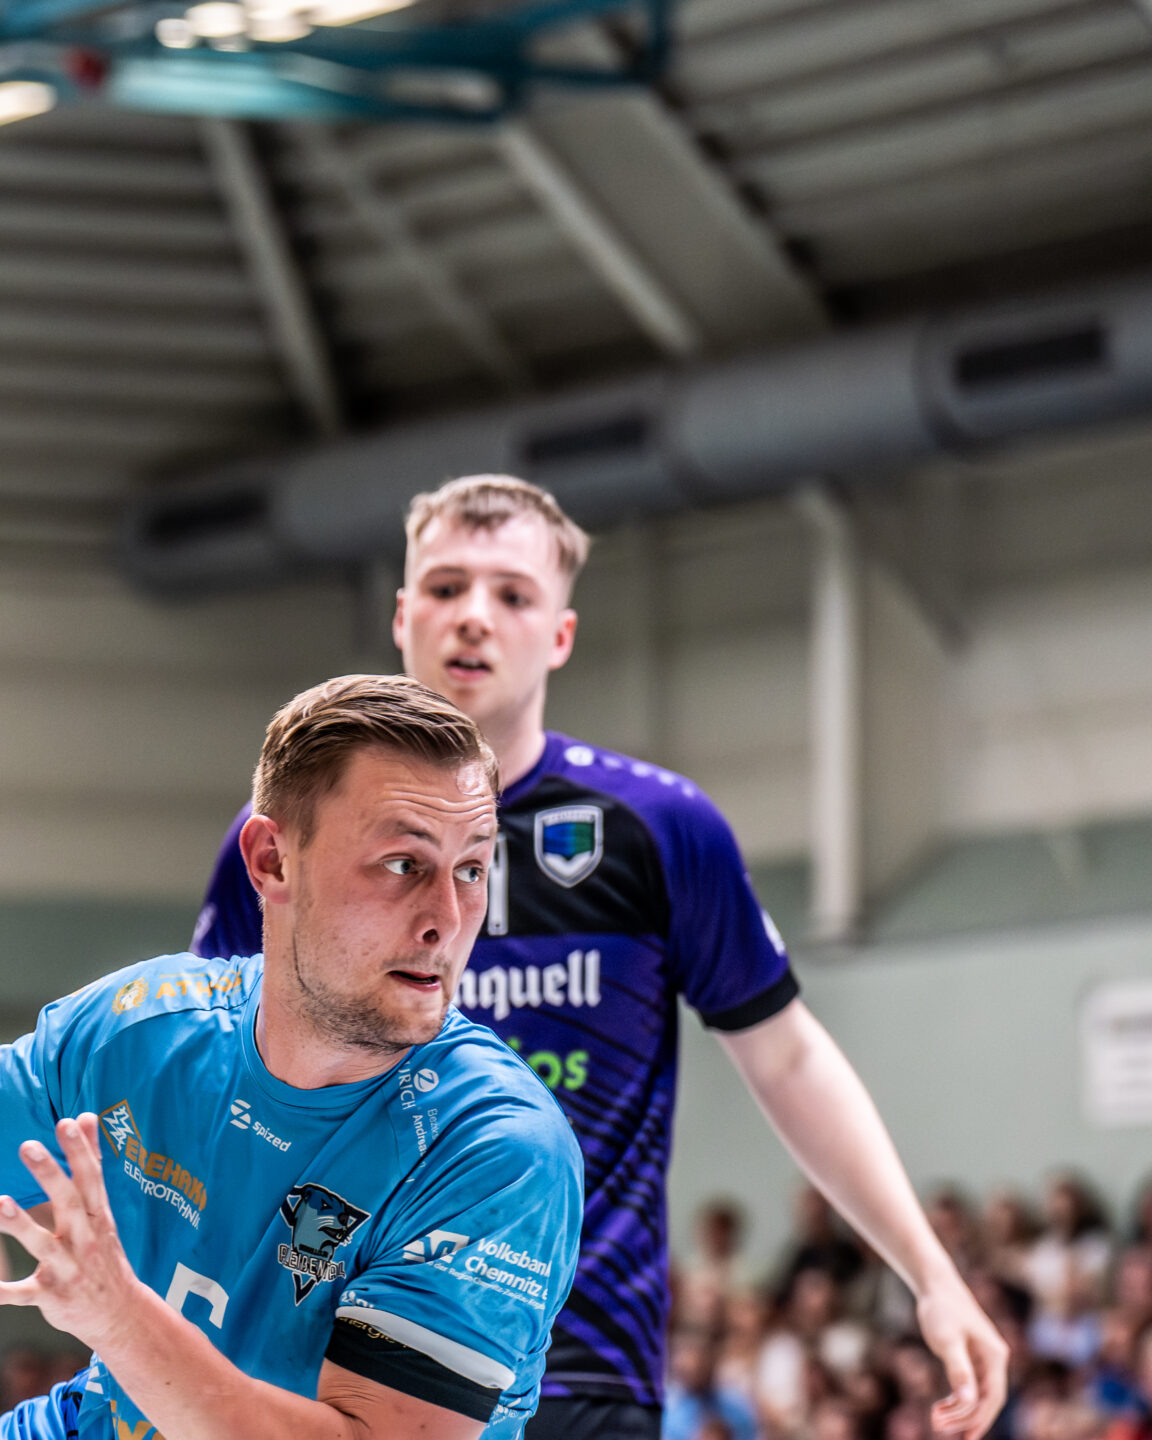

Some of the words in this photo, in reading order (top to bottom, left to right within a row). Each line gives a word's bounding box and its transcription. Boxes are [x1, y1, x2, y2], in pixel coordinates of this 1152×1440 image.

[455, 949, 601, 1021] nquell
[251, 1121, 292, 1152] spized
[464, 1256, 542, 1297] Chemnitz
